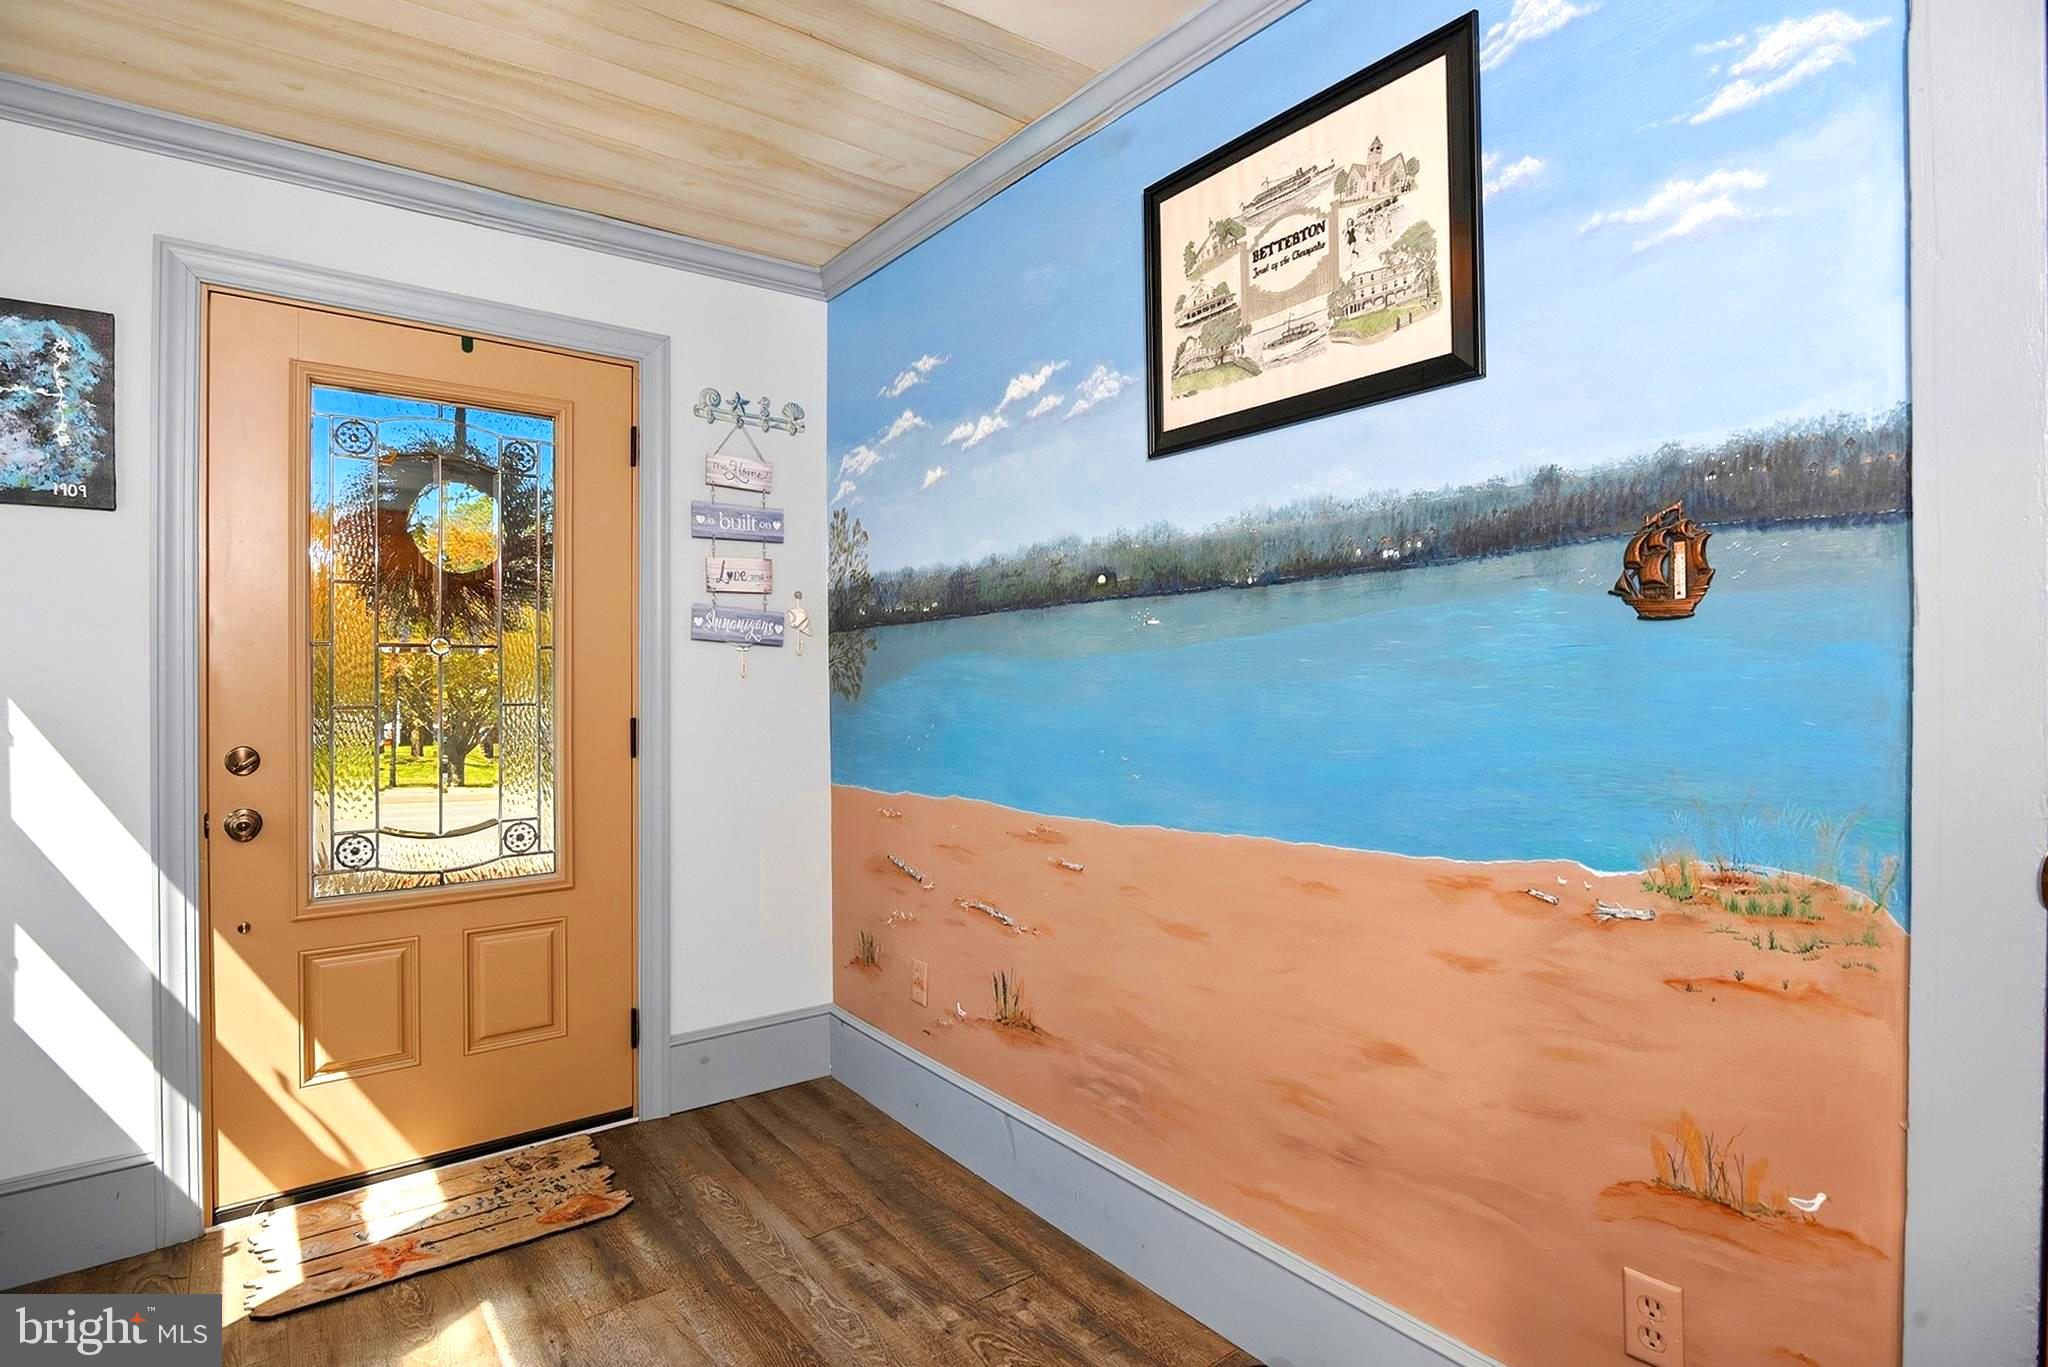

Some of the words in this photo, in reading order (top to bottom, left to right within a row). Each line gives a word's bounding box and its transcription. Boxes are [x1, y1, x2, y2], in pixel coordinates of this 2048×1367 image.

[1271, 262, 1279, 271] of
[53, 482, 87, 498] 1909
[719, 511, 757, 531] built
[759, 521, 772, 529] on
